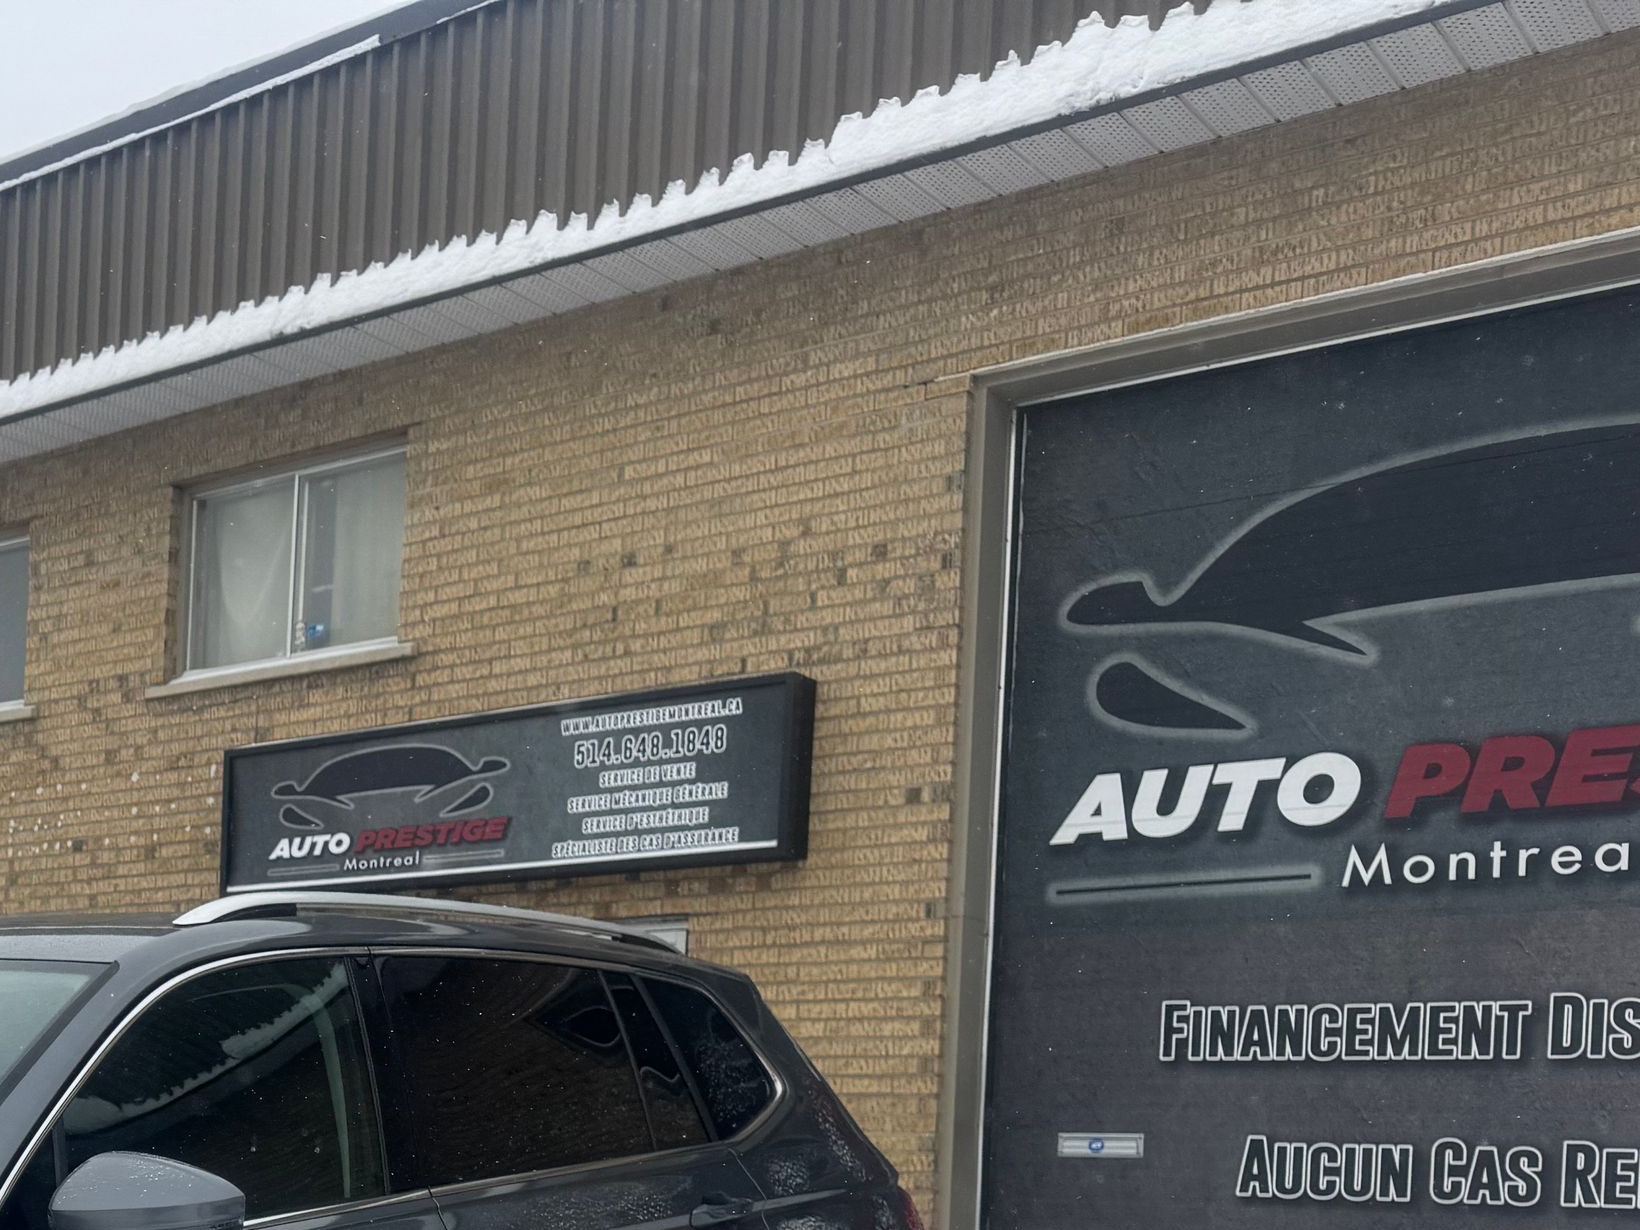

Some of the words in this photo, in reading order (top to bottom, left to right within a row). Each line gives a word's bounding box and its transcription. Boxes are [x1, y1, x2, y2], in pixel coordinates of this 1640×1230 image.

[574, 724, 727, 769] 514.648.1848
[599, 767, 643, 788] SERVICE
[645, 765, 659, 784] DE
[662, 762, 696, 781] VENTE
[1049, 751, 1361, 846] AUTO
[1384, 723, 1640, 819] PRE
[567, 793, 611, 814] SERVICE
[582, 814, 625, 834] SERVICE
[269, 832, 351, 860] AUTO
[356, 817, 509, 853] PRESTIGE
[344, 851, 420, 870] Montreal
[1341, 840, 1629, 887] Montrea
[1159, 1000, 1531, 1061] FINANCEMENT
[1547, 992, 1640, 1060] DIS
[1236, 1135, 1413, 1202] AUCUN
[1429, 1137, 1542, 1206] CAS
[1561, 1140, 1640, 1209] RE
